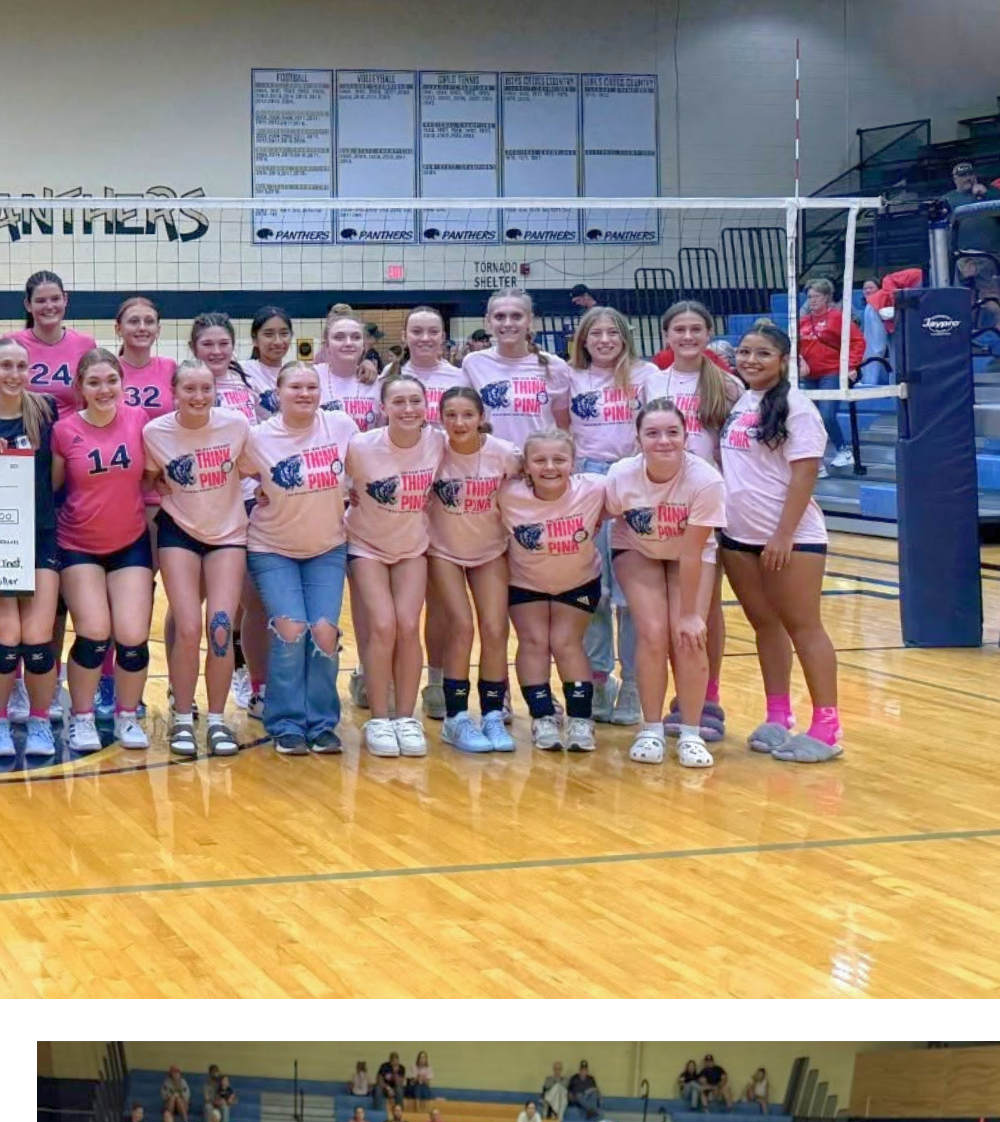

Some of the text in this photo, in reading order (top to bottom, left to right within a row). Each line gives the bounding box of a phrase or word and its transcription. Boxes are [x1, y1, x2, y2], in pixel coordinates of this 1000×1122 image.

[275, 230, 330, 240] PANTHERS
[358, 230, 413, 240] PANTHERS
[441, 230, 496, 240] PANTHERS
[523, 230, 576, 240] PANTHERS
[604, 230, 655, 240] PANTHERS
[474, 261, 517, 273] TORNADO
[474, 277, 517, 288] SHELTER
[922, 316, 961, 328] Jaypro
[31, 364, 72, 386] 24
[513, 380, 547, 394] THINK
[124, 386, 162, 408] 32
[87, 445, 132, 474] 14
[195, 448, 231, 469] THINK
[303, 447, 339, 470] THINK
[199, 472, 227, 488] PINK
[308, 472, 339, 489] PINK
[546, 516, 584, 539] THINK
